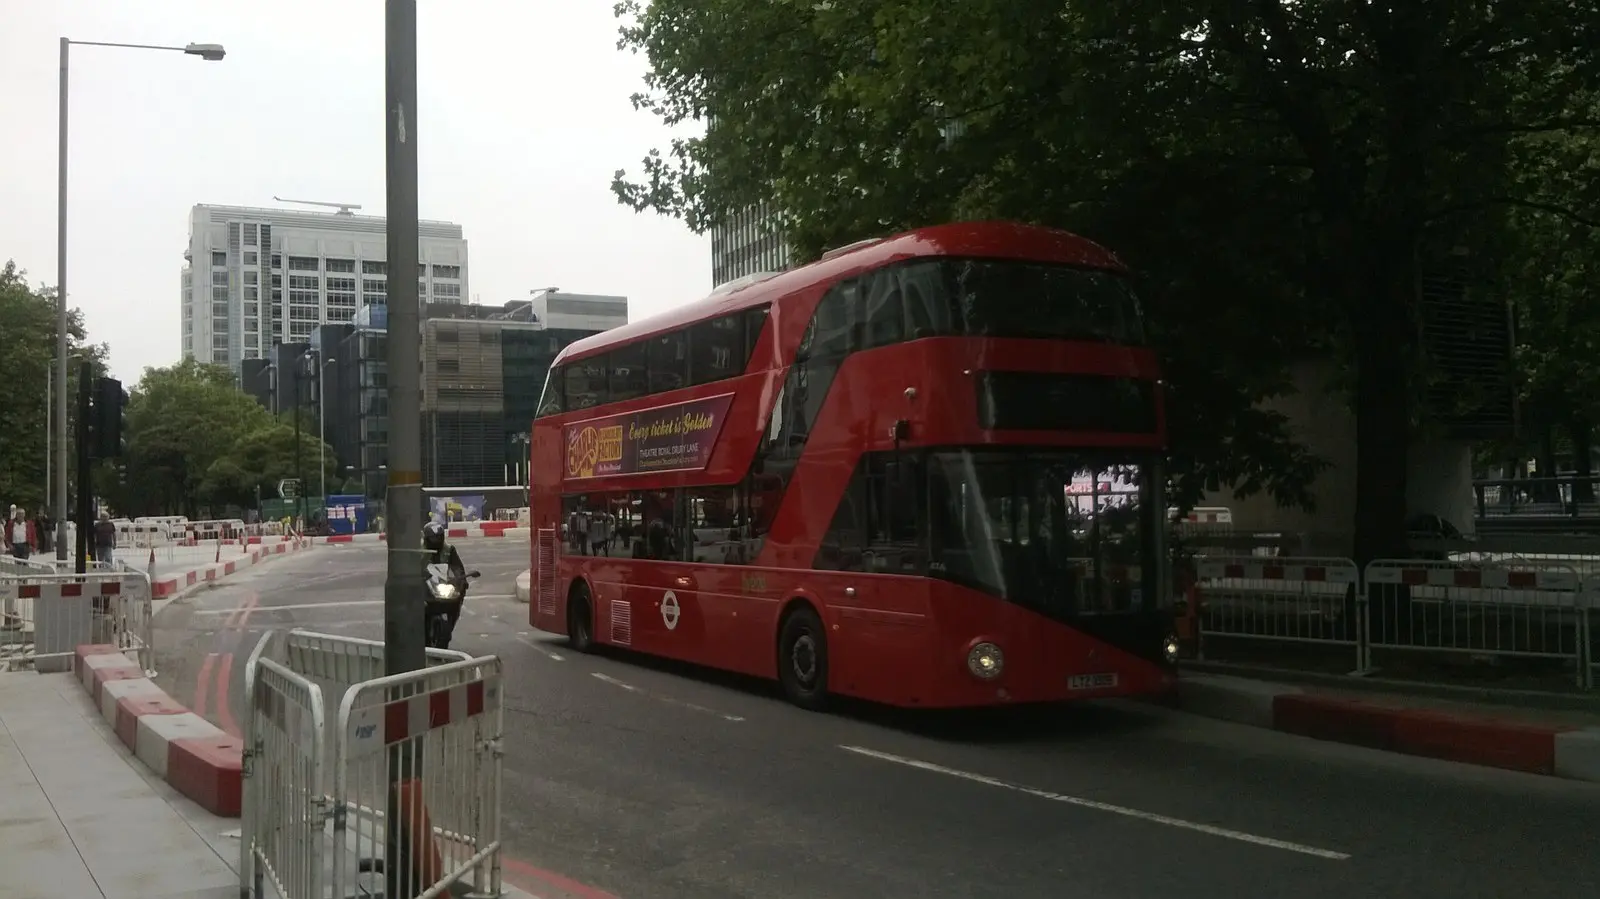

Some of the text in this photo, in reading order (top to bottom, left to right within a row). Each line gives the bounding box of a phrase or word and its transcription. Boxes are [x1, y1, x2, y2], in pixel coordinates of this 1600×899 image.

[629, 422, 649, 444] Every
[651, 419, 673, 437] ticket
[675, 417, 682, 433] is
[682, 412, 714, 436] Golden
[640, 447, 658, 459] THEATRE
[658, 445, 672, 457] ROYAL
[687, 443, 699, 454] LANE
